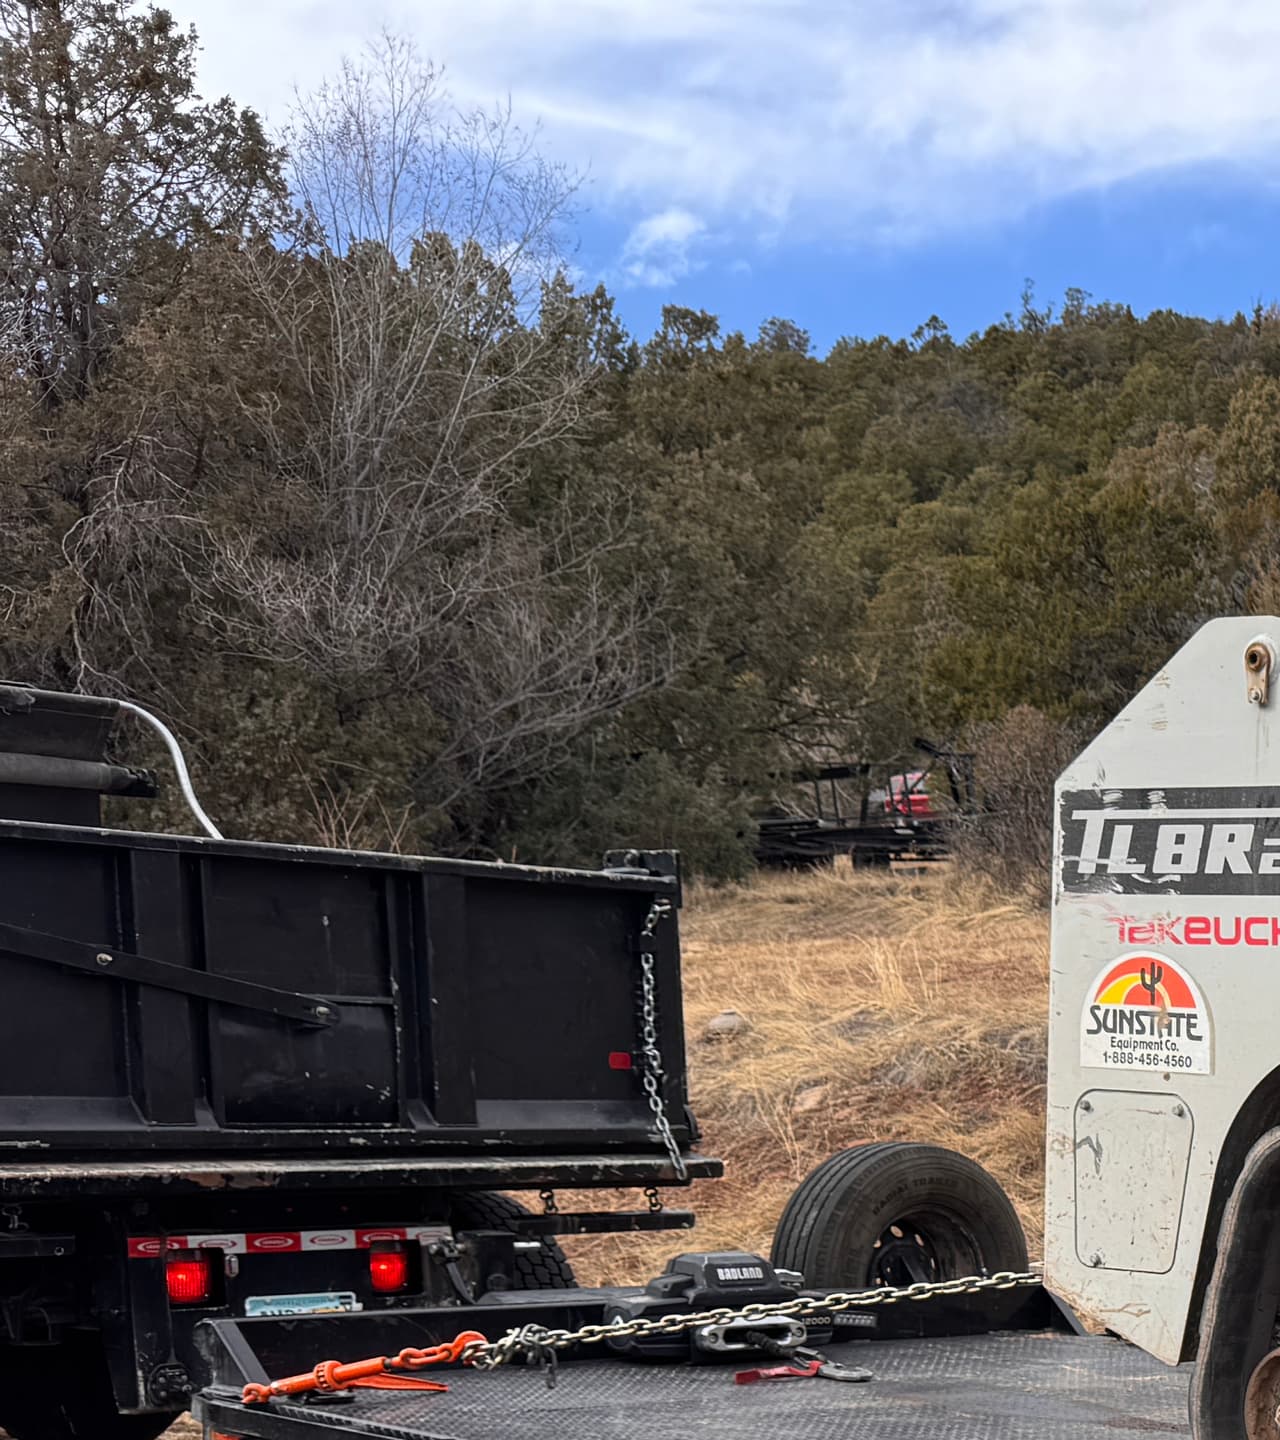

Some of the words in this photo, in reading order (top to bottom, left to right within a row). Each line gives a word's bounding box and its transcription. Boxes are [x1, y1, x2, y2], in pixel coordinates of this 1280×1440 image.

[1086, 1005, 1203, 1042] SUNSTATE
[1110, 1036, 1163, 1052] Equipment
[1165, 1040, 1179, 1052] Co.
[1103, 1051, 1192, 1068] 1-888-456-4560
[716, 1267, 764, 1281] BADLAND
